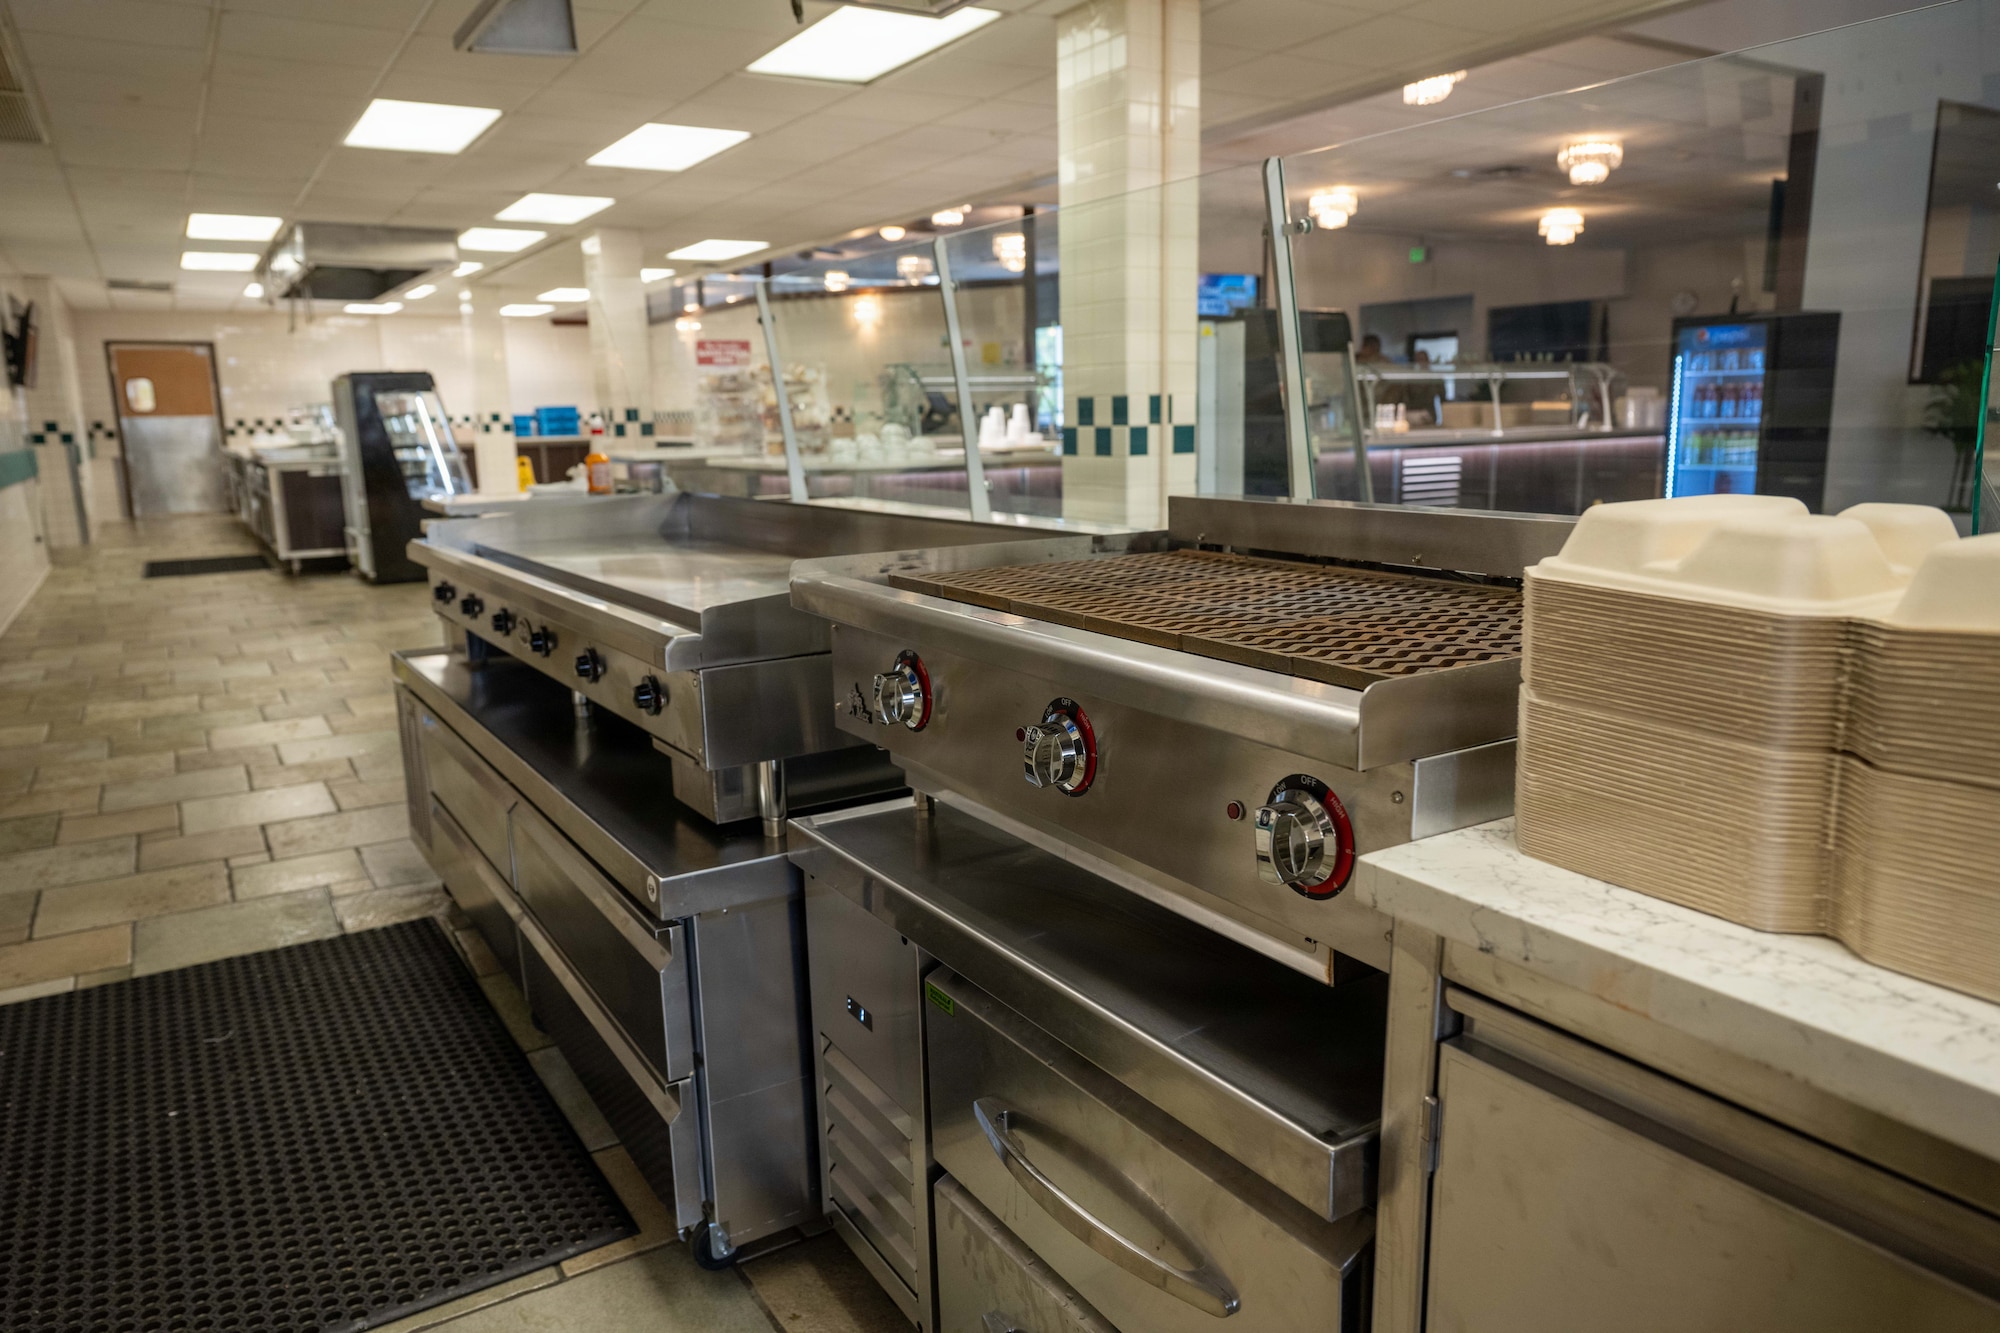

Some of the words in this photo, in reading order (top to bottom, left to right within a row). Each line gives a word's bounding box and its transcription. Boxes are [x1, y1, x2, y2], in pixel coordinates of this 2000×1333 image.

[1061, 698, 1072, 707] OFF
[1300, 775, 1317, 787] OFF
[1273, 781, 1287, 796] LOW
[1331, 797, 1346, 819] HIGH
